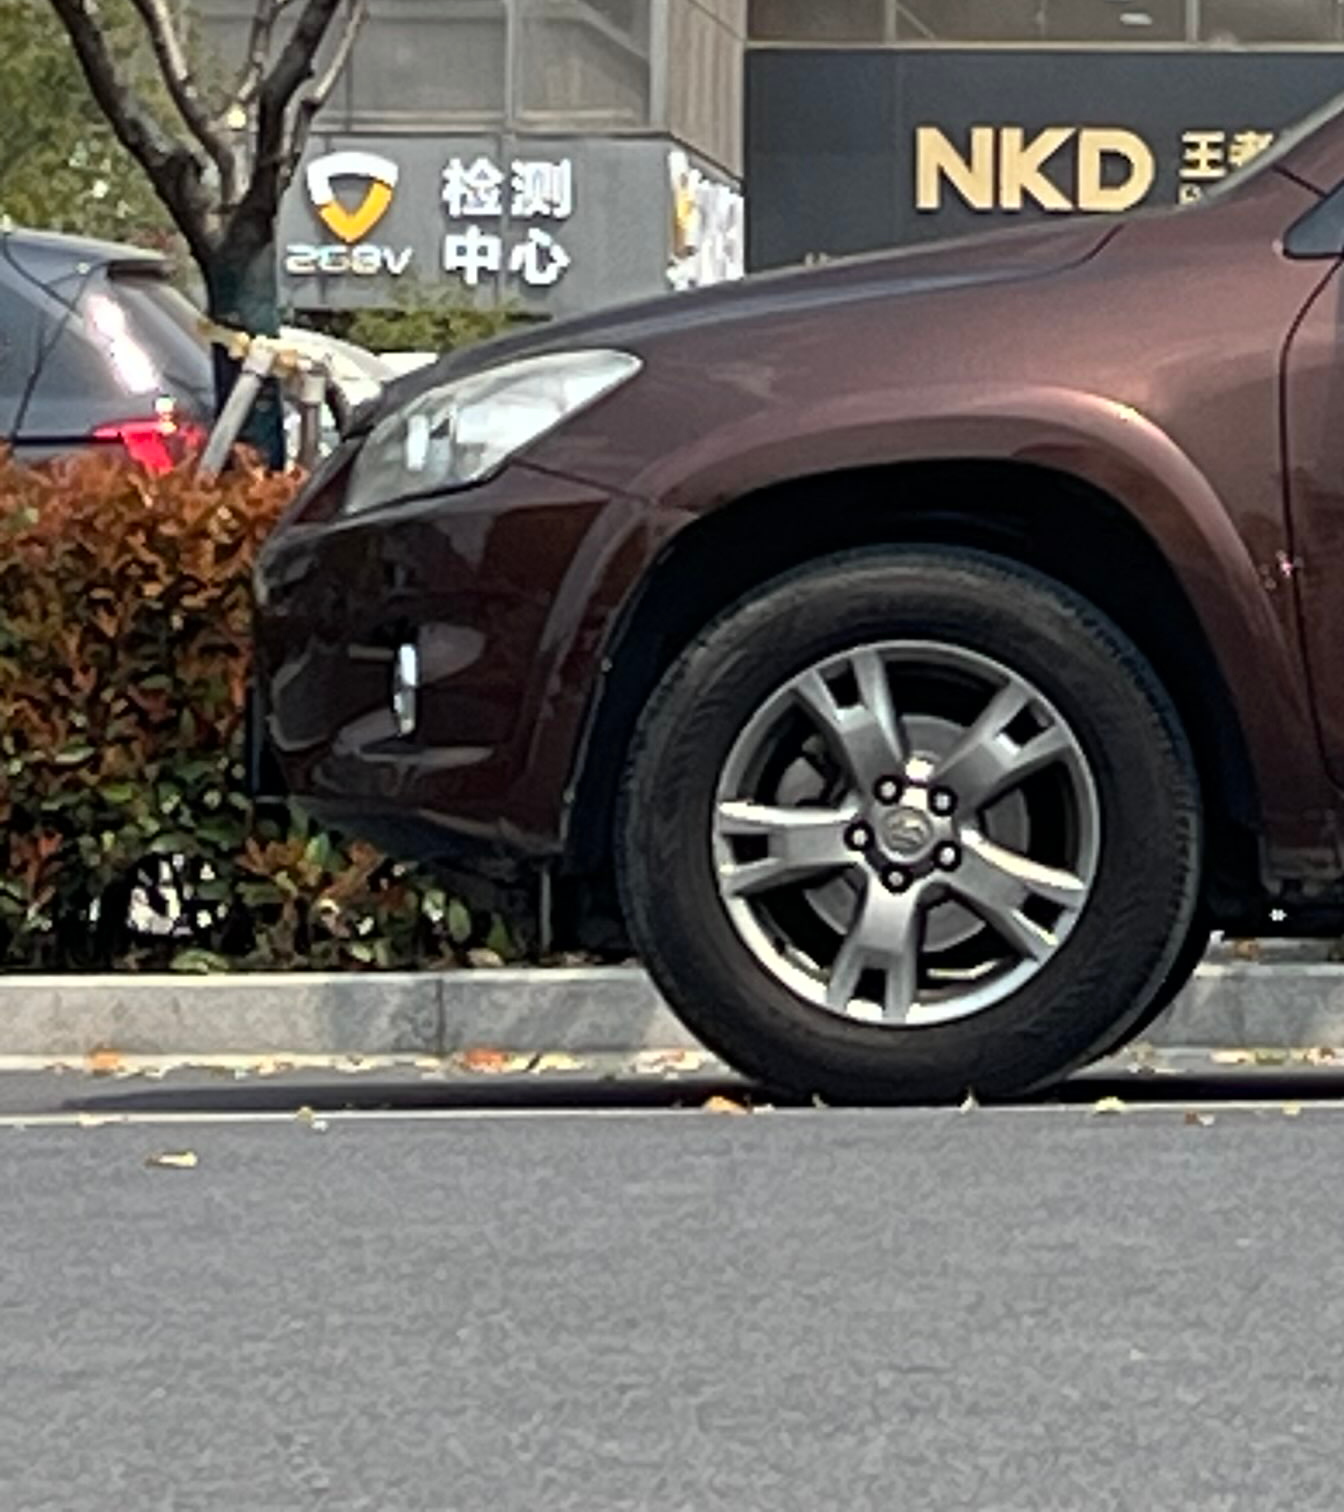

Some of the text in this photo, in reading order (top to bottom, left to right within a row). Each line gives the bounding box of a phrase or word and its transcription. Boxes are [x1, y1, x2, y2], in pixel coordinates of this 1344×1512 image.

[441, 157, 573, 218] 检测
[915, 127, 1155, 211] NKD
[443, 225, 571, 286] 中心
